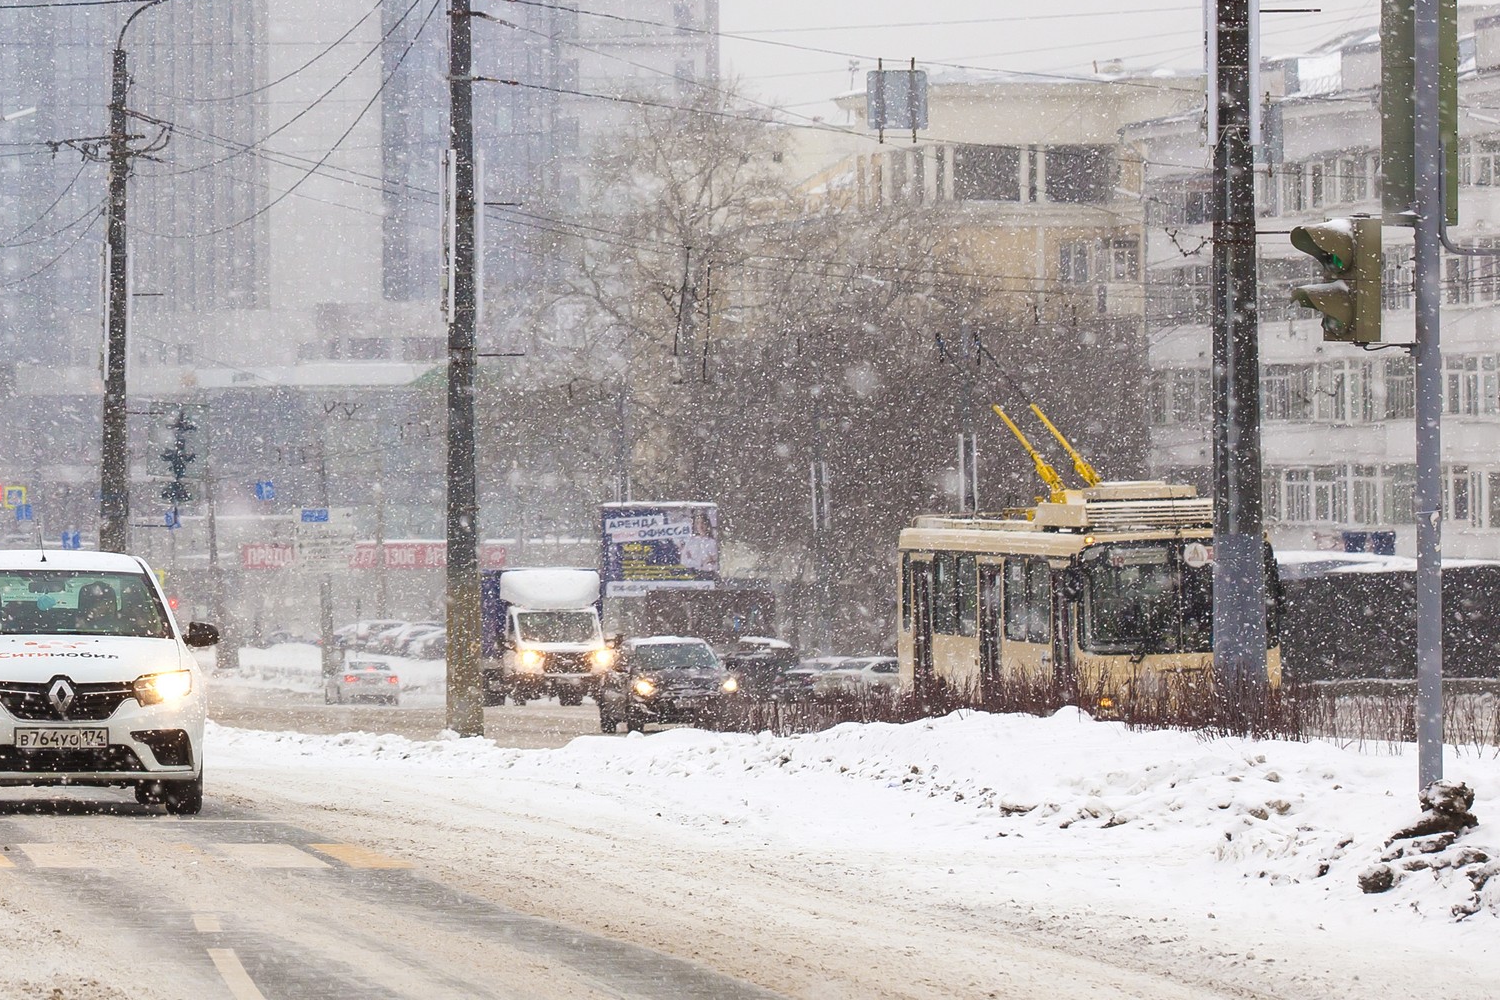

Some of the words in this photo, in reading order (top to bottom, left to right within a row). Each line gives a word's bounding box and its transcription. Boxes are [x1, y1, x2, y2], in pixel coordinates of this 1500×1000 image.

[609, 518, 657, 529] АРЕНДА
[638, 526, 690, 538] ОФИСОВ
[20, 731, 79, 746] В764УО
[82, 730, 104, 742] 174
